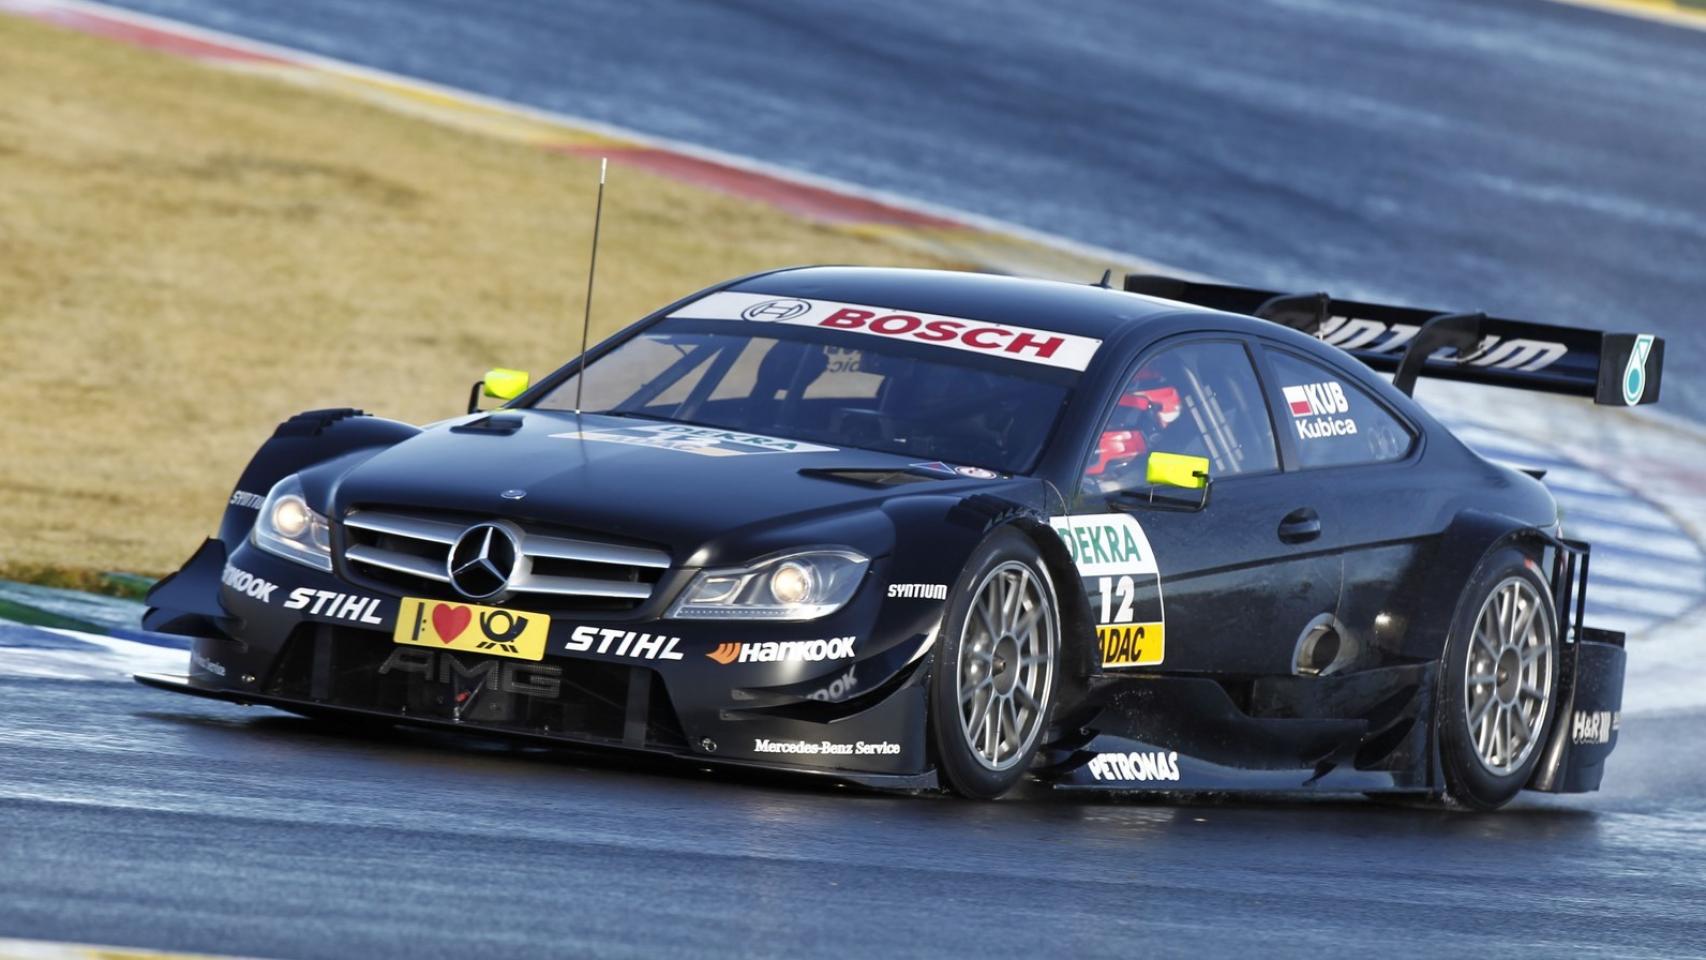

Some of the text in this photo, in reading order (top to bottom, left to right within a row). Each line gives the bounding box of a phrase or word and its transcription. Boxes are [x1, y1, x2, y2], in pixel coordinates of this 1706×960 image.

[818, 308, 1065, 358] BOSCH
[1303, 381, 1349, 416] KUB
[663, 426, 798, 450] DEKRA
[1295, 417, 1357, 439] Kubica
[1057, 524, 1142, 564] DEKRA
[283, 587, 383, 624] STIHL
[887, 584, 948, 600] SYNTIUM
[1099, 576, 1135, 623] 12
[565, 626, 684, 660] STIHL
[378, 648, 562, 698] AMG
[754, 738, 900, 754] Mercedes-Benz Service
[1088, 751, 1180, 781] PETRONAS
